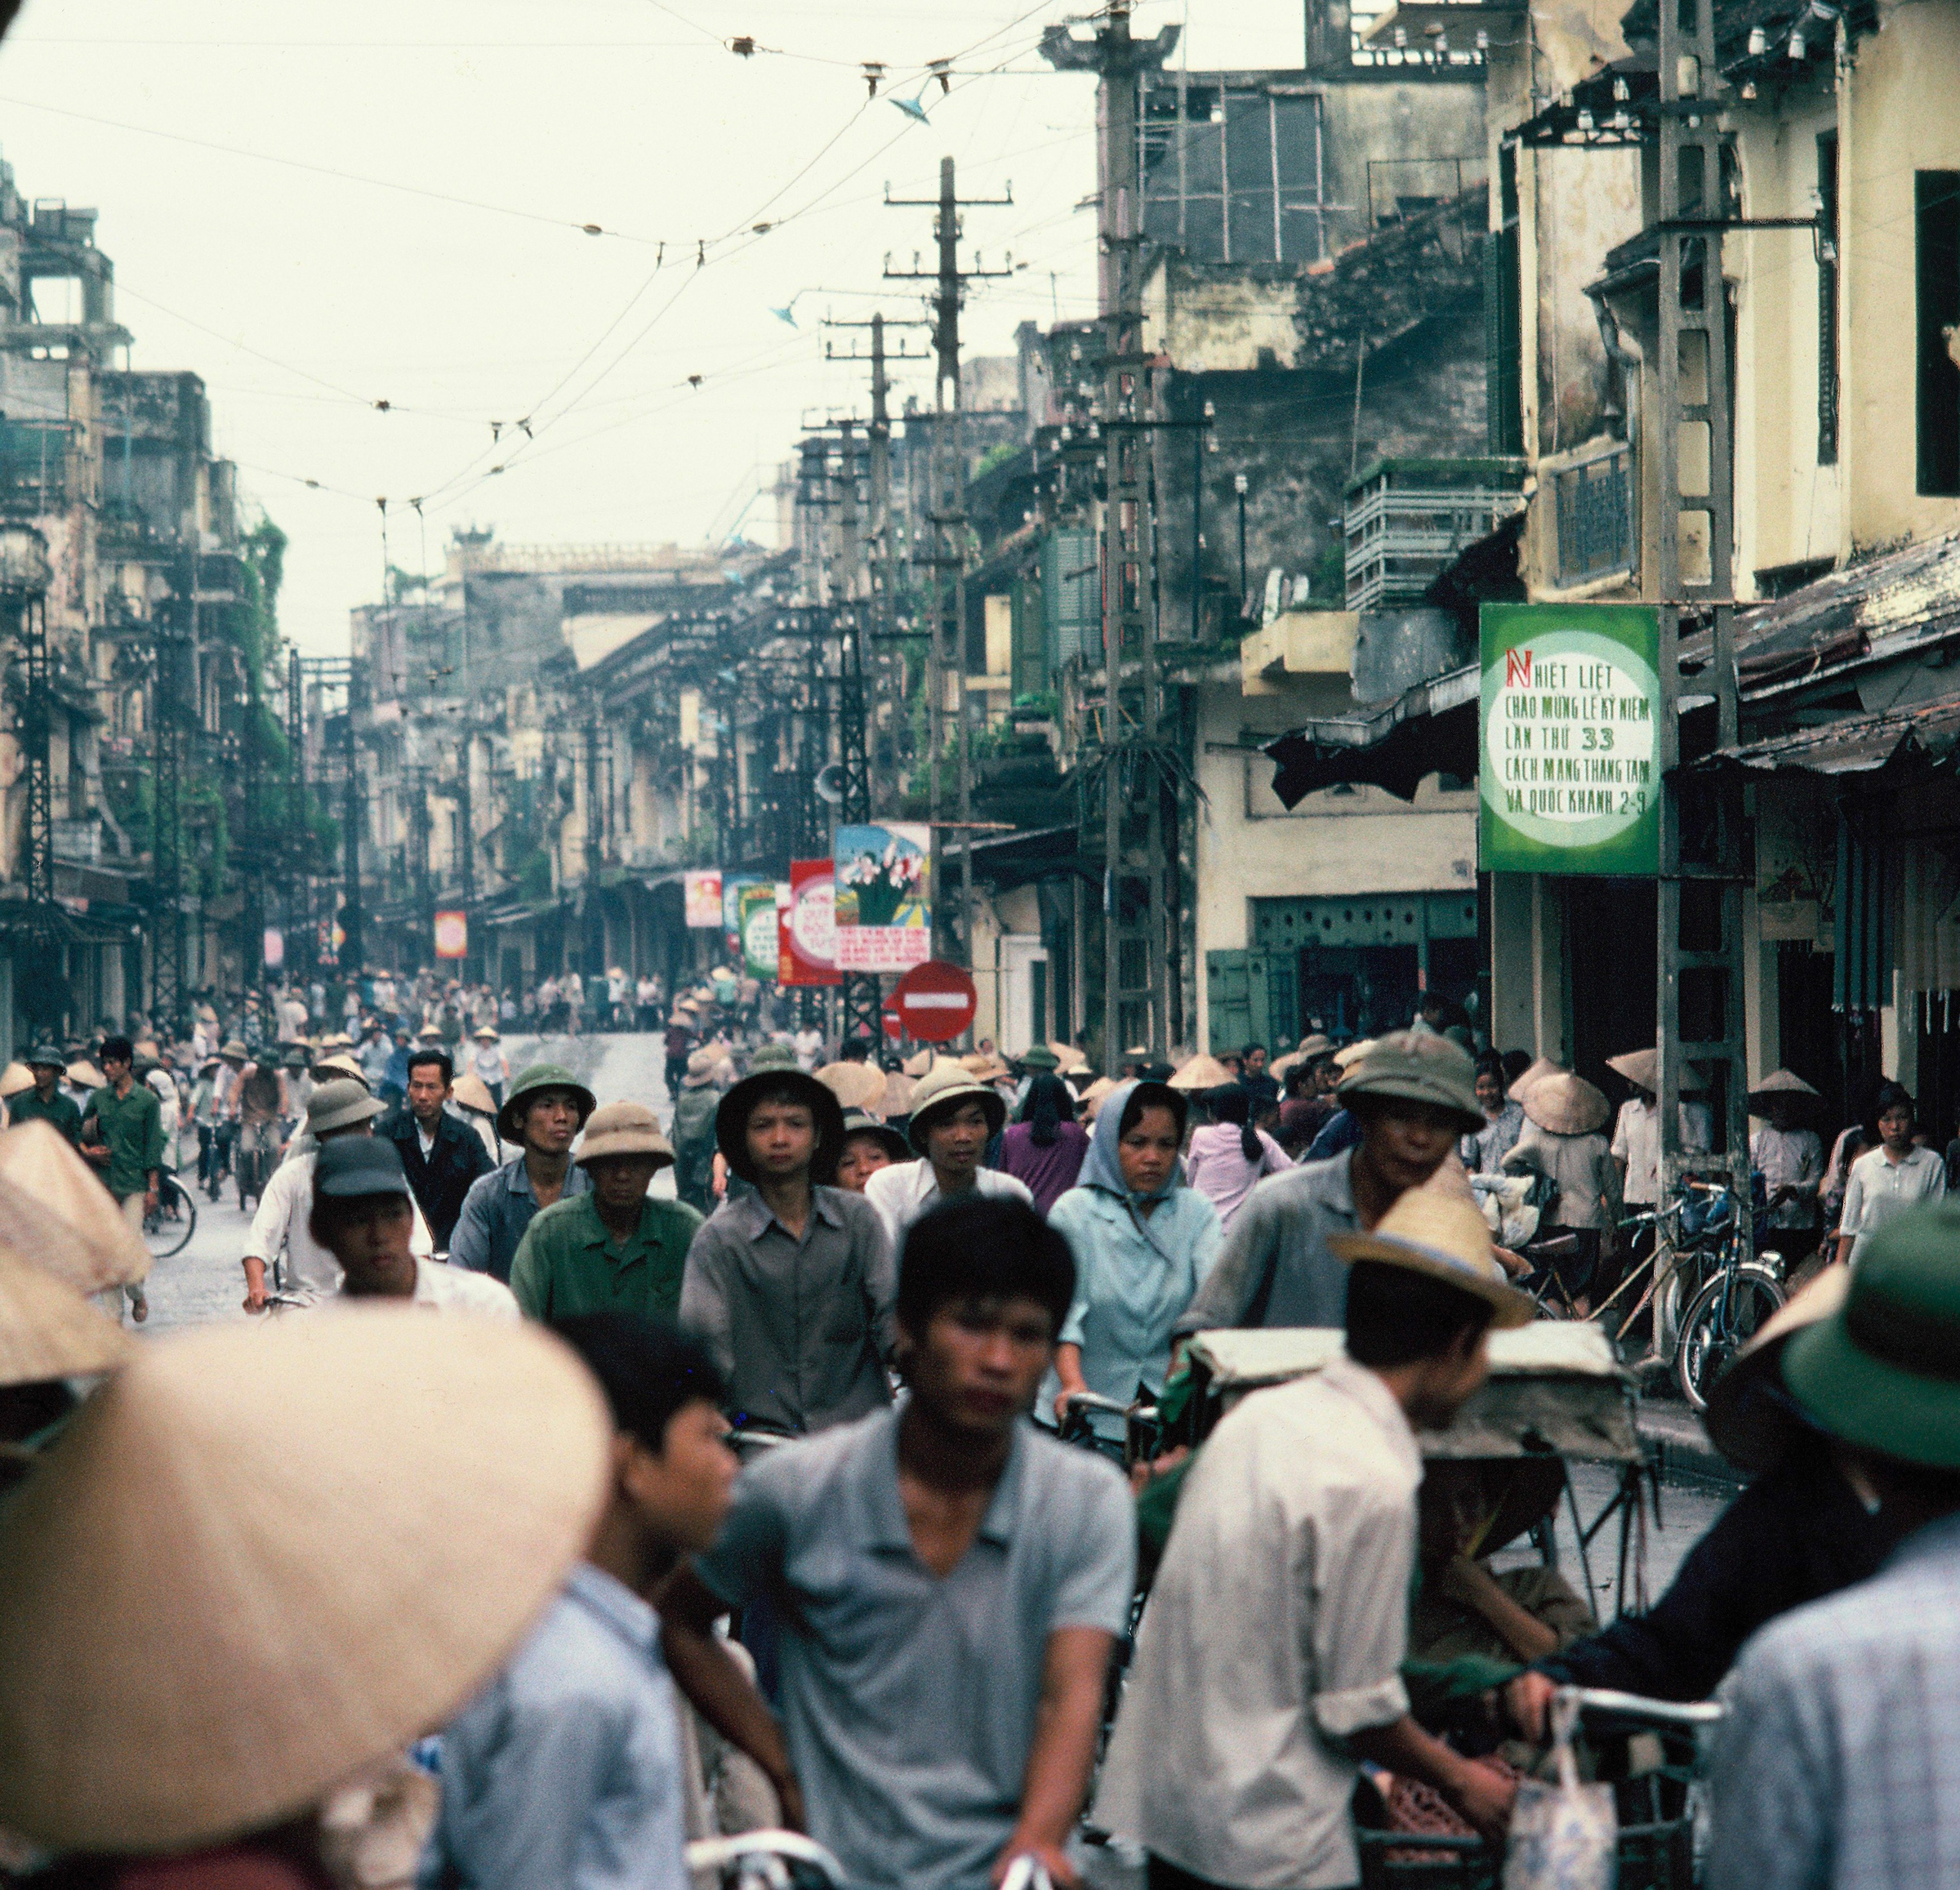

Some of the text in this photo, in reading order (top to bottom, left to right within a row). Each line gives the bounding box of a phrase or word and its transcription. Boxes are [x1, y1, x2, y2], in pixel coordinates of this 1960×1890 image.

[1506, 649, 1612, 691] NHIỆT LIỆT
[1505, 693, 1537, 719] CHÀO
[1542, 723, 1570, 750] THỨ
[1581, 727, 1615, 751] 33
[1505, 754, 1538, 782] CÁCH
[1584, 756, 1623, 783] THÁNG
[1626, 756, 1650, 784] TÁM
[1506, 785, 1523, 814] VÀ
[1619, 790, 1646, 815] 2-9
